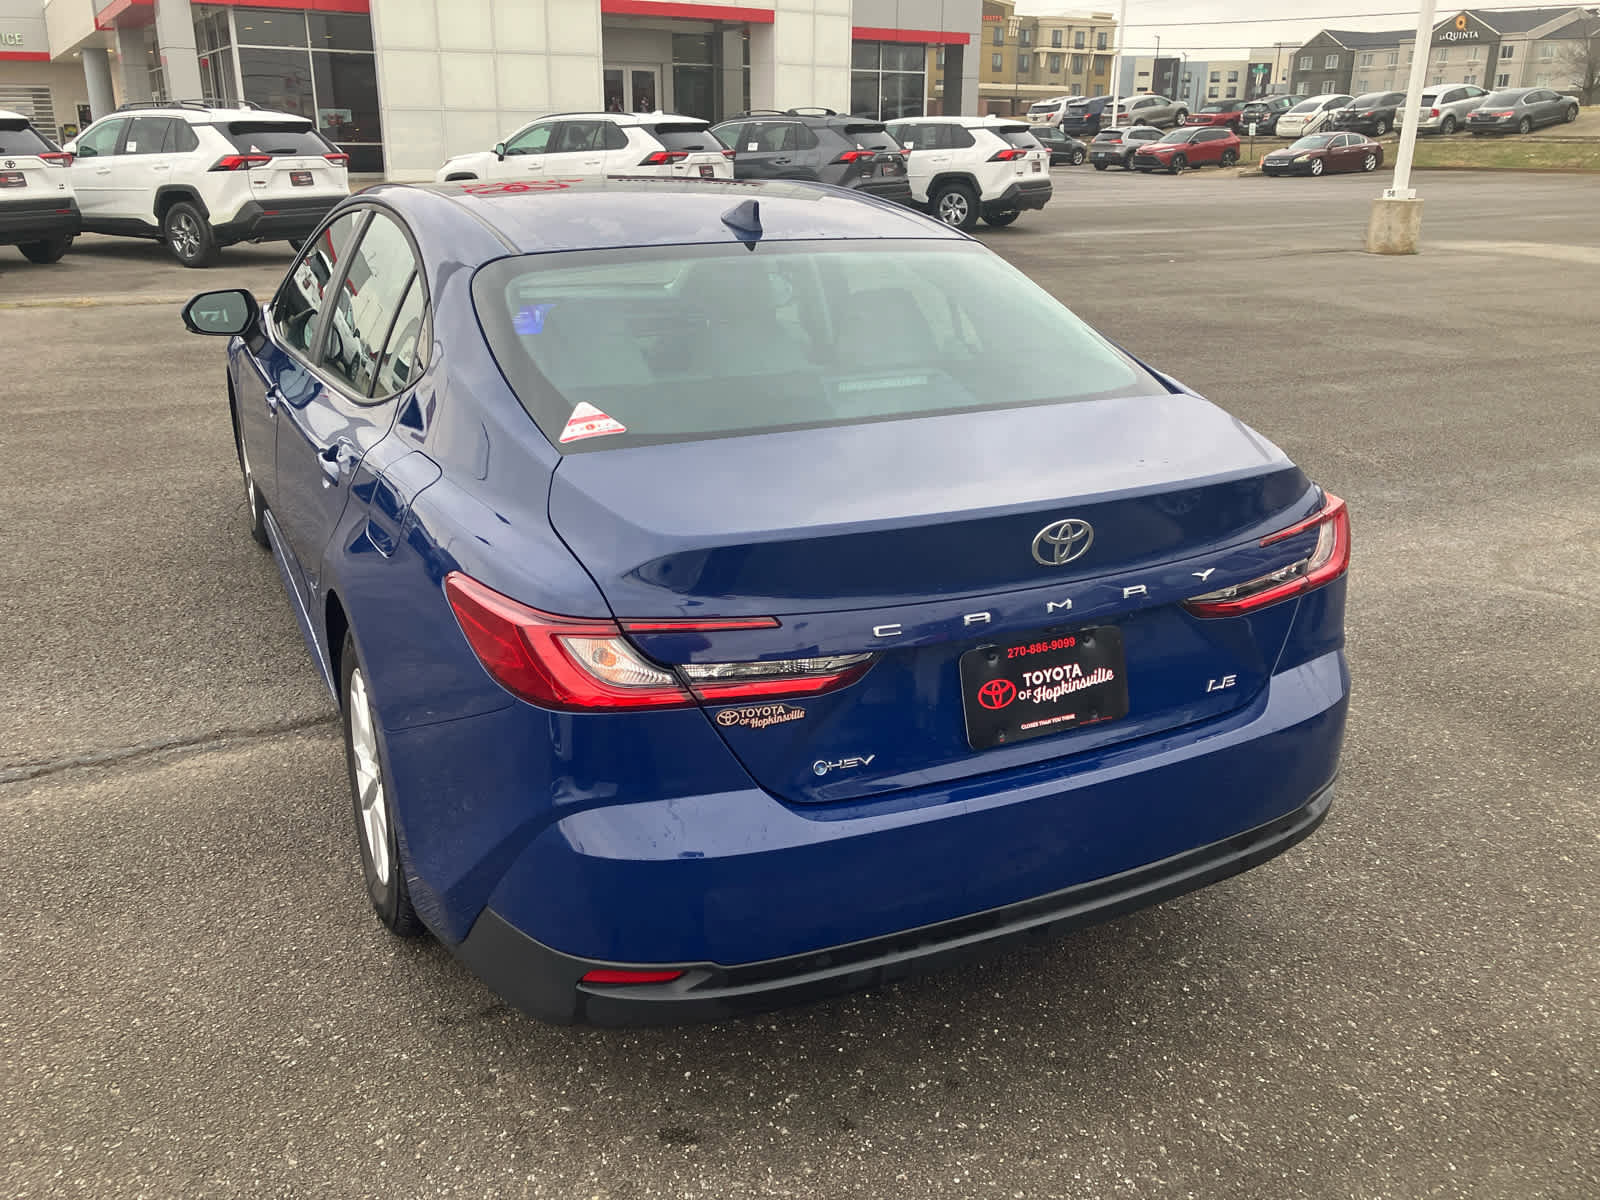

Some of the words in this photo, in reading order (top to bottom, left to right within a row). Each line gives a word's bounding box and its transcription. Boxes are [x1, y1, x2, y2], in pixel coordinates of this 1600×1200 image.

[1445, 31, 1479, 41] QUINTA
[872, 567, 1216, 638] CAMRY
[1022, 663, 1083, 687] TOYOTA
[1206, 674, 1237, 693] LE
[1018, 689, 1032, 701] OF
[1032, 667, 1115, 704] Hopkinsville
[739, 705, 786, 718] TOYOTA
[739, 718, 750, 726] OF
[749, 709, 806, 729] Hopkinsville
